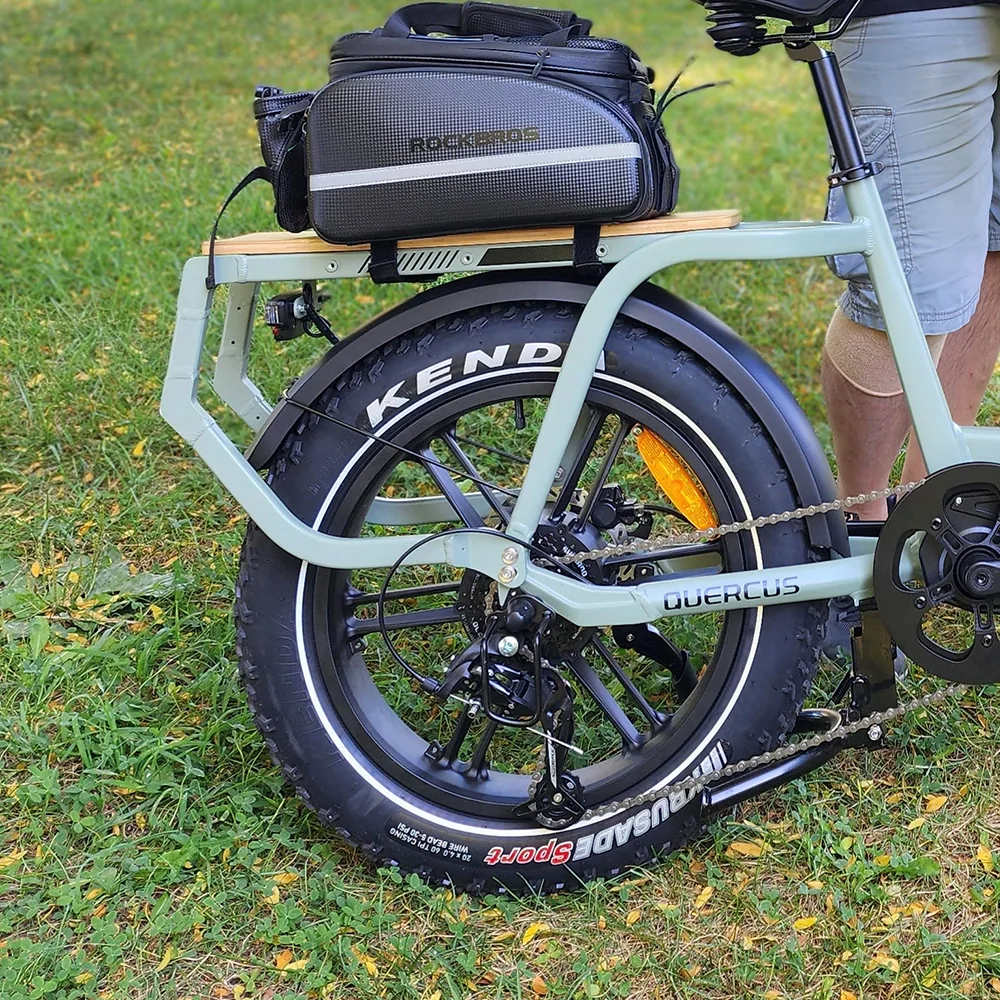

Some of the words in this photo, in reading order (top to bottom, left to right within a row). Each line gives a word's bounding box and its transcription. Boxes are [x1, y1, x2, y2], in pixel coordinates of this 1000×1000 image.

[409, 126, 539, 152] ROCKBROS
[366, 342, 606, 428] KEND
[663, 576, 800, 611] QUERCUS
[397, 822, 410, 833] PSI
[389, 827, 417, 846] CASING
[409, 829, 426, 841] 5-30
[417, 842, 430, 853] TPI
[426, 836, 448, 848] BEAD
[449, 843, 469, 854] WIRE
[484, 838, 574, 866] Sport
[462, 853, 472, 862] 20
